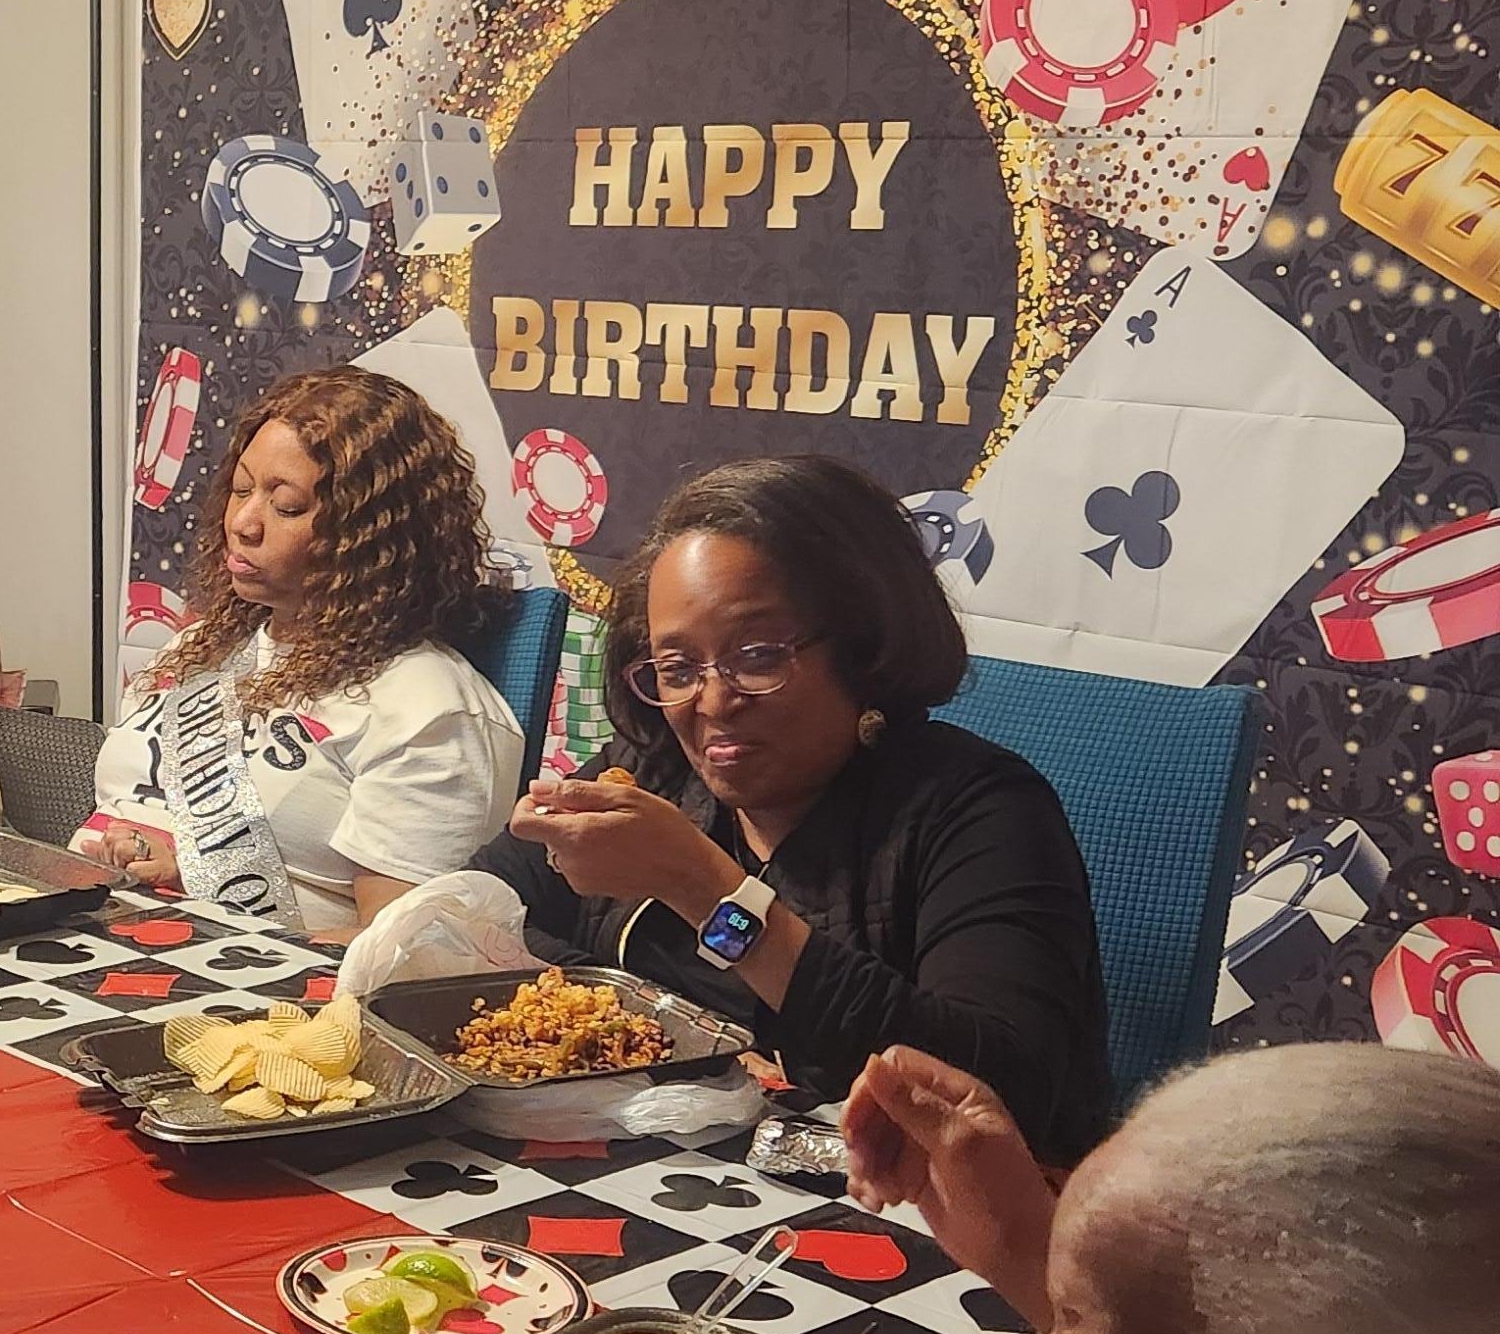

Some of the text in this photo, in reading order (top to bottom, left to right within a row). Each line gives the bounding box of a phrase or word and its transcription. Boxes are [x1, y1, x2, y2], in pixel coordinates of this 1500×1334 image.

[568, 120, 911, 231] HAPPY
[1154, 265, 1192, 309] A
[488, 296, 996, 426] BIRTHDAY
[176, 679, 257, 858] BIRTHDAY
